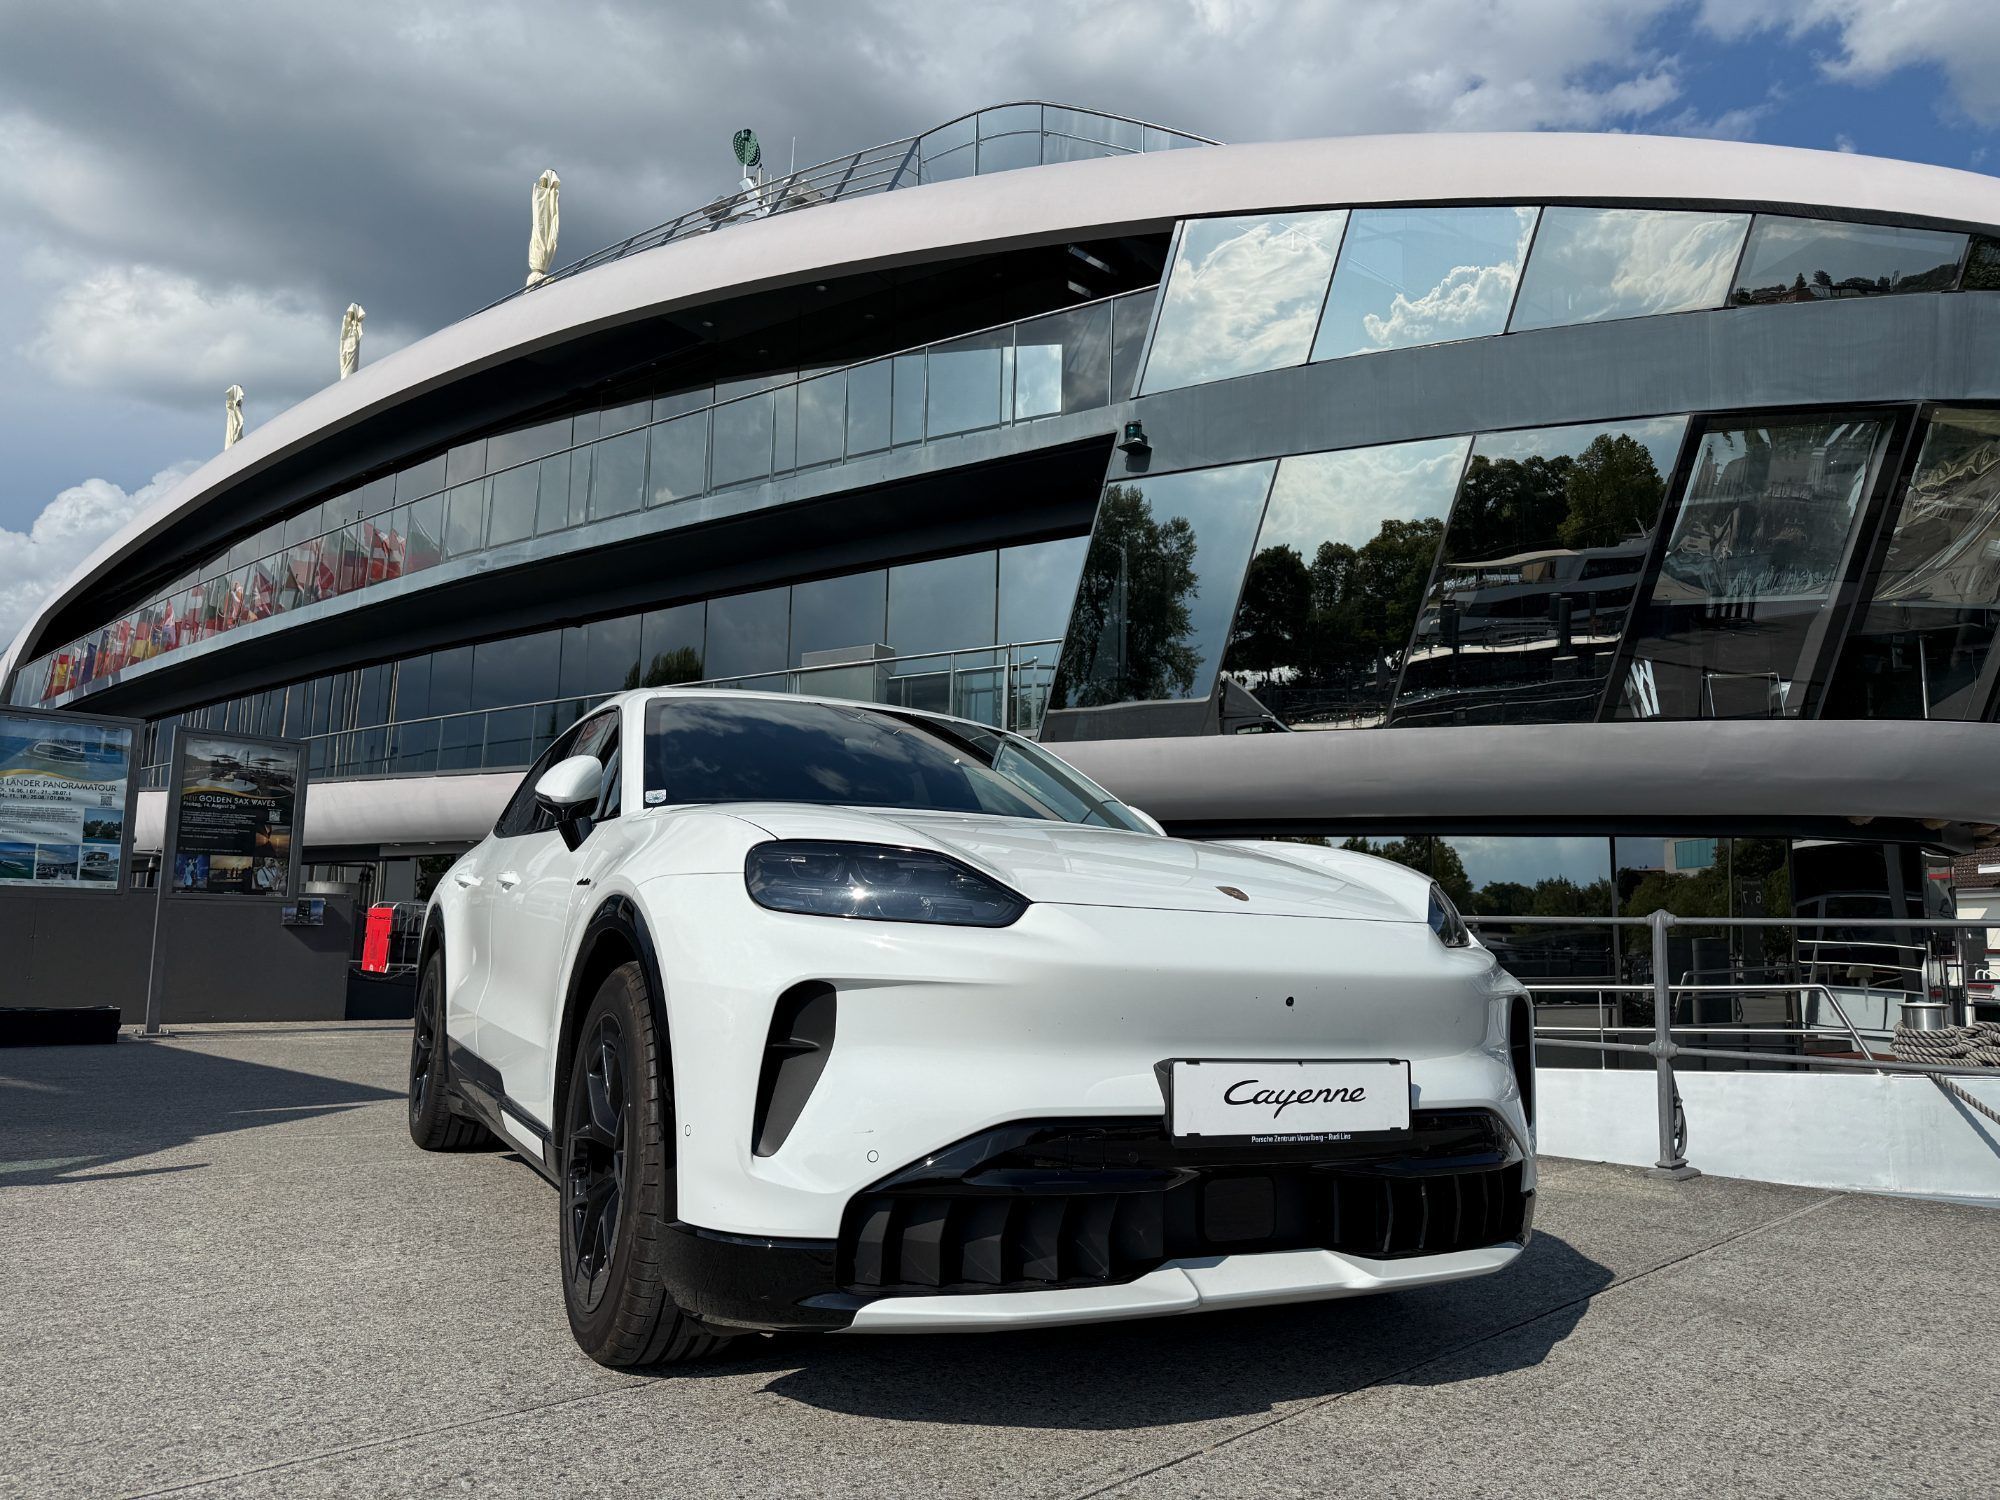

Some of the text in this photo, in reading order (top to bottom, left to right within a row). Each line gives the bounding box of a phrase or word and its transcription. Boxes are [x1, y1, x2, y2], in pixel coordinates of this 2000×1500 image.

[6, 778, 40, 787] LÄNDER
[43, 780, 116, 792] PANORAMATOUR
[199, 795, 232, 803] GOLDEN
[234, 797, 249, 806] SAX
[1224, 1079, 1366, 1119] Cayenne
